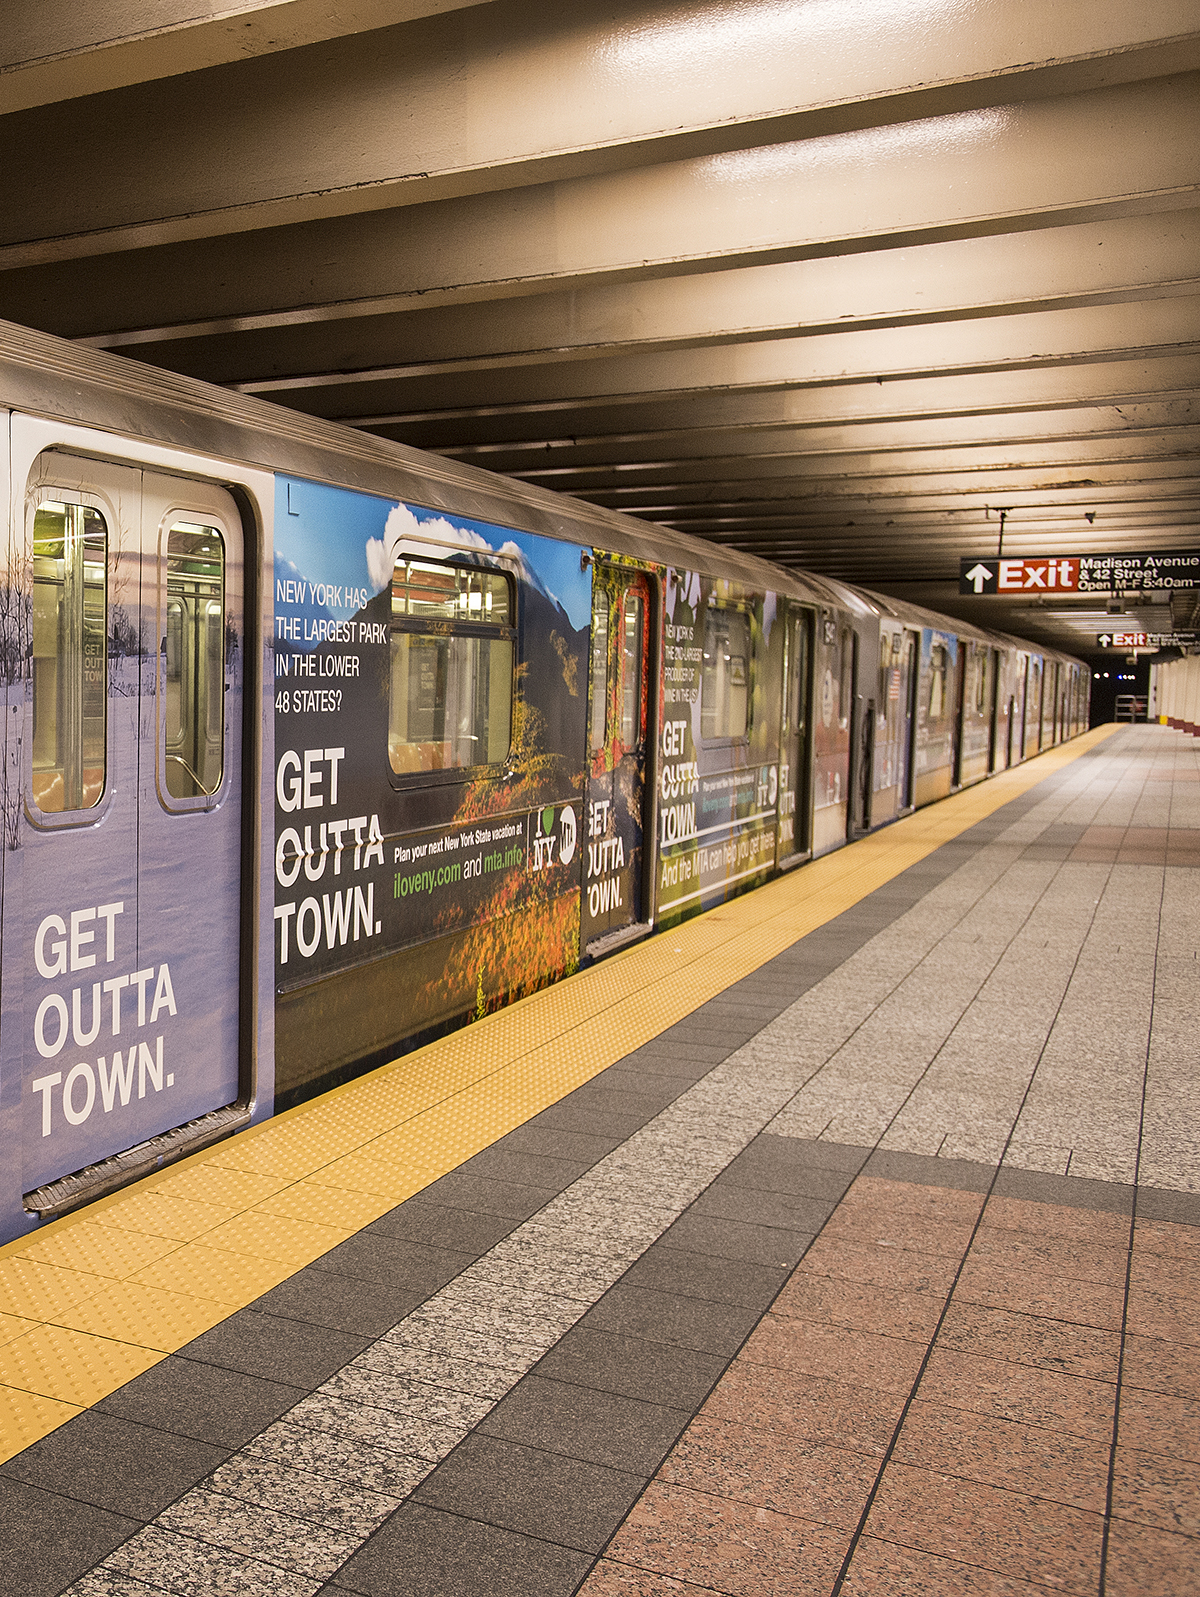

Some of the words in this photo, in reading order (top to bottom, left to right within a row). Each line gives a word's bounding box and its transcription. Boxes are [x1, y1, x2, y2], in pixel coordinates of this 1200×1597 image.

[998, 560, 1074, 589] Exit
[1079, 570, 1089, 580] &
[1092, 569, 1110, 580] 42
[1113, 568, 1158, 579] Street
[1080, 557, 1141, 569] Madison
[1144, 556, 1199, 567] Avenue
[276, 578, 306, 603] NEW
[308, 581, 342, 607] YORK
[345, 586, 368, 609] HAS
[1078, 580, 1111, 592] Open
[1115, 579, 1141, 589] M-F
[276, 616, 302, 641] THE
[304, 618, 357, 644] LARGEST
[359, 620, 387, 644] PARK
[1112, 633, 1145, 646] Exit
[84, 643, 100, 655] GET
[84, 657, 103, 668] OUT
[275, 653, 289, 676] IN
[292, 654, 316, 677] THE
[318, 654, 360, 678] LOWER
[275, 689, 290, 713] 48
[292, 689, 343, 713] STATES?
[663, 720, 687, 758] GET
[275, 747, 345, 813] GET
[661, 761, 700, 801] OUTTA
[780, 764, 790, 788] ET
[535, 806, 545, 838] I
[660, 801, 698, 844] TOWN.
[275, 813, 385, 888] OUTTA
[394, 847, 411, 864] Plan
[411, 844, 428, 863] your
[428, 840, 444, 854] next
[444, 836, 459, 852] New
[459, 832, 475, 848] York
[475, 829, 492, 844] State
[492, 824, 517, 841] vacation
[516, 821, 523, 835] at
[532, 835, 557, 872] NY
[393, 862, 461, 899] iloveny.com
[463, 852, 482, 879] and
[484, 844, 523, 874] mta.info
[661, 859, 678, 889] And
[679, 855, 692, 882] the
[692, 849, 709, 877] MTA
[709, 848, 723, 870] can
[723, 841, 737, 869] help
[737, 841, 749, 867] you
[749, 835, 760, 861] get
[587, 876, 623, 918] OWN.
[34, 901, 124, 979] GET
[274, 882, 382, 965] TOWN.
[34, 963, 178, 1058] OUTTA
[32, 1036, 175, 1138] TOWN.
